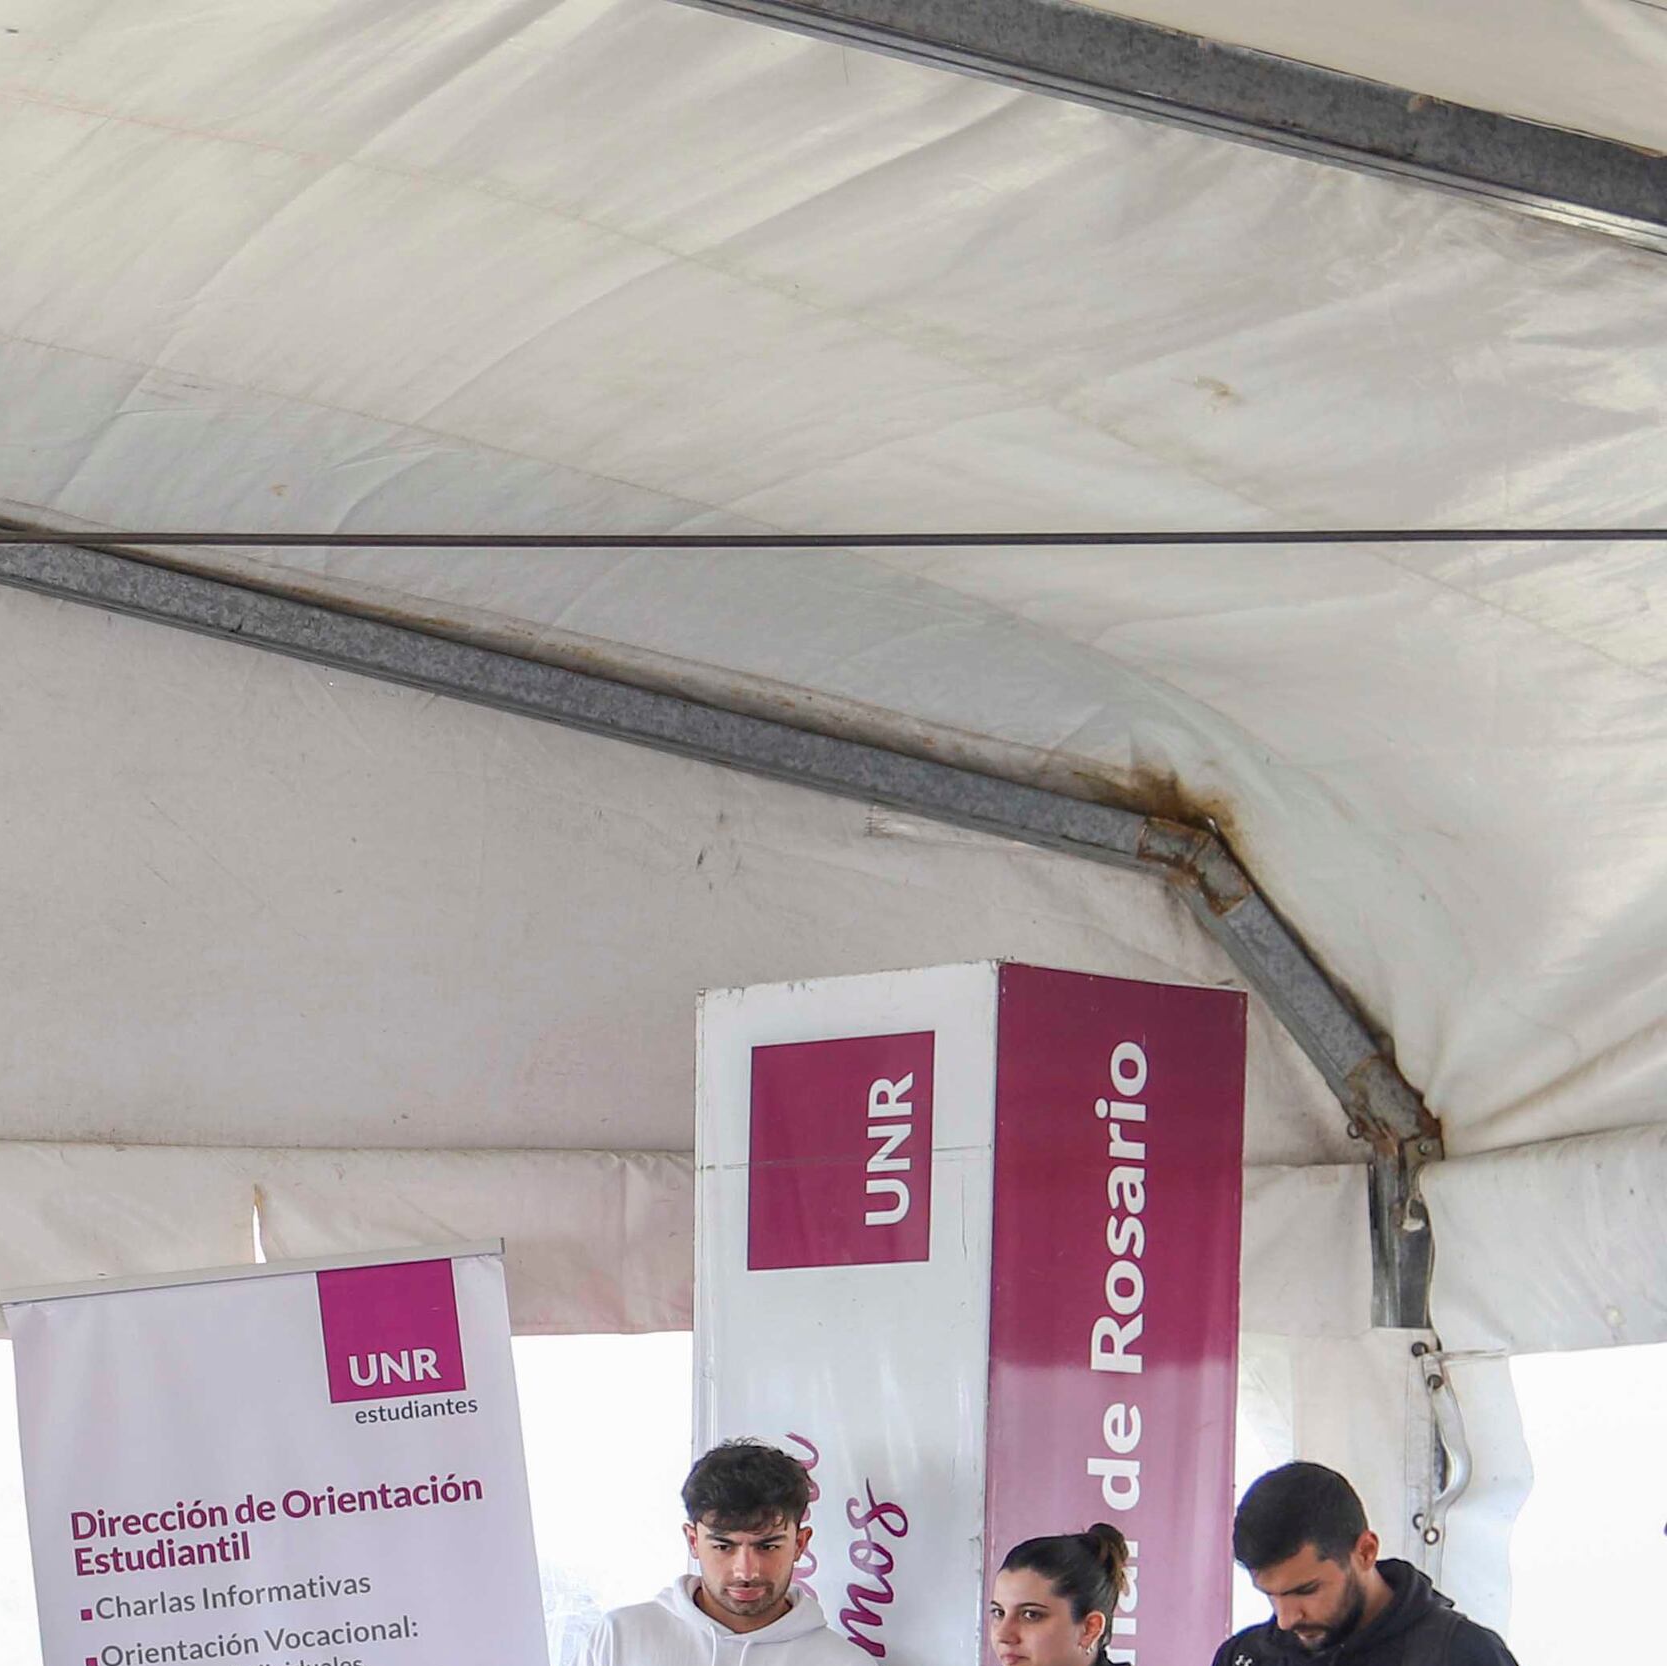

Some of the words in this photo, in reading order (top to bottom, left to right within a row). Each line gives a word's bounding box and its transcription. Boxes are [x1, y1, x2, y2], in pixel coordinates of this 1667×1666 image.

[864, 1070, 915, 1226] UNR
[1090, 1040, 1149, 1374] Rosario
[348, 1348, 442, 1387] UNR
[355, 1398, 478, 1424] estudiantes
[1087, 1403, 1142, 1511] de
[71, 1500, 229, 1540] Dirección
[235, 1494, 276, 1524] de
[282, 1474, 484, 1519] Orientación
[74, 1531, 251, 1576] Estudiantil
[95, 1590, 196, 1620] Charlas
[202, 1575, 372, 1611] Informativas
[263, 1614, 420, 1652] Vocacional:
